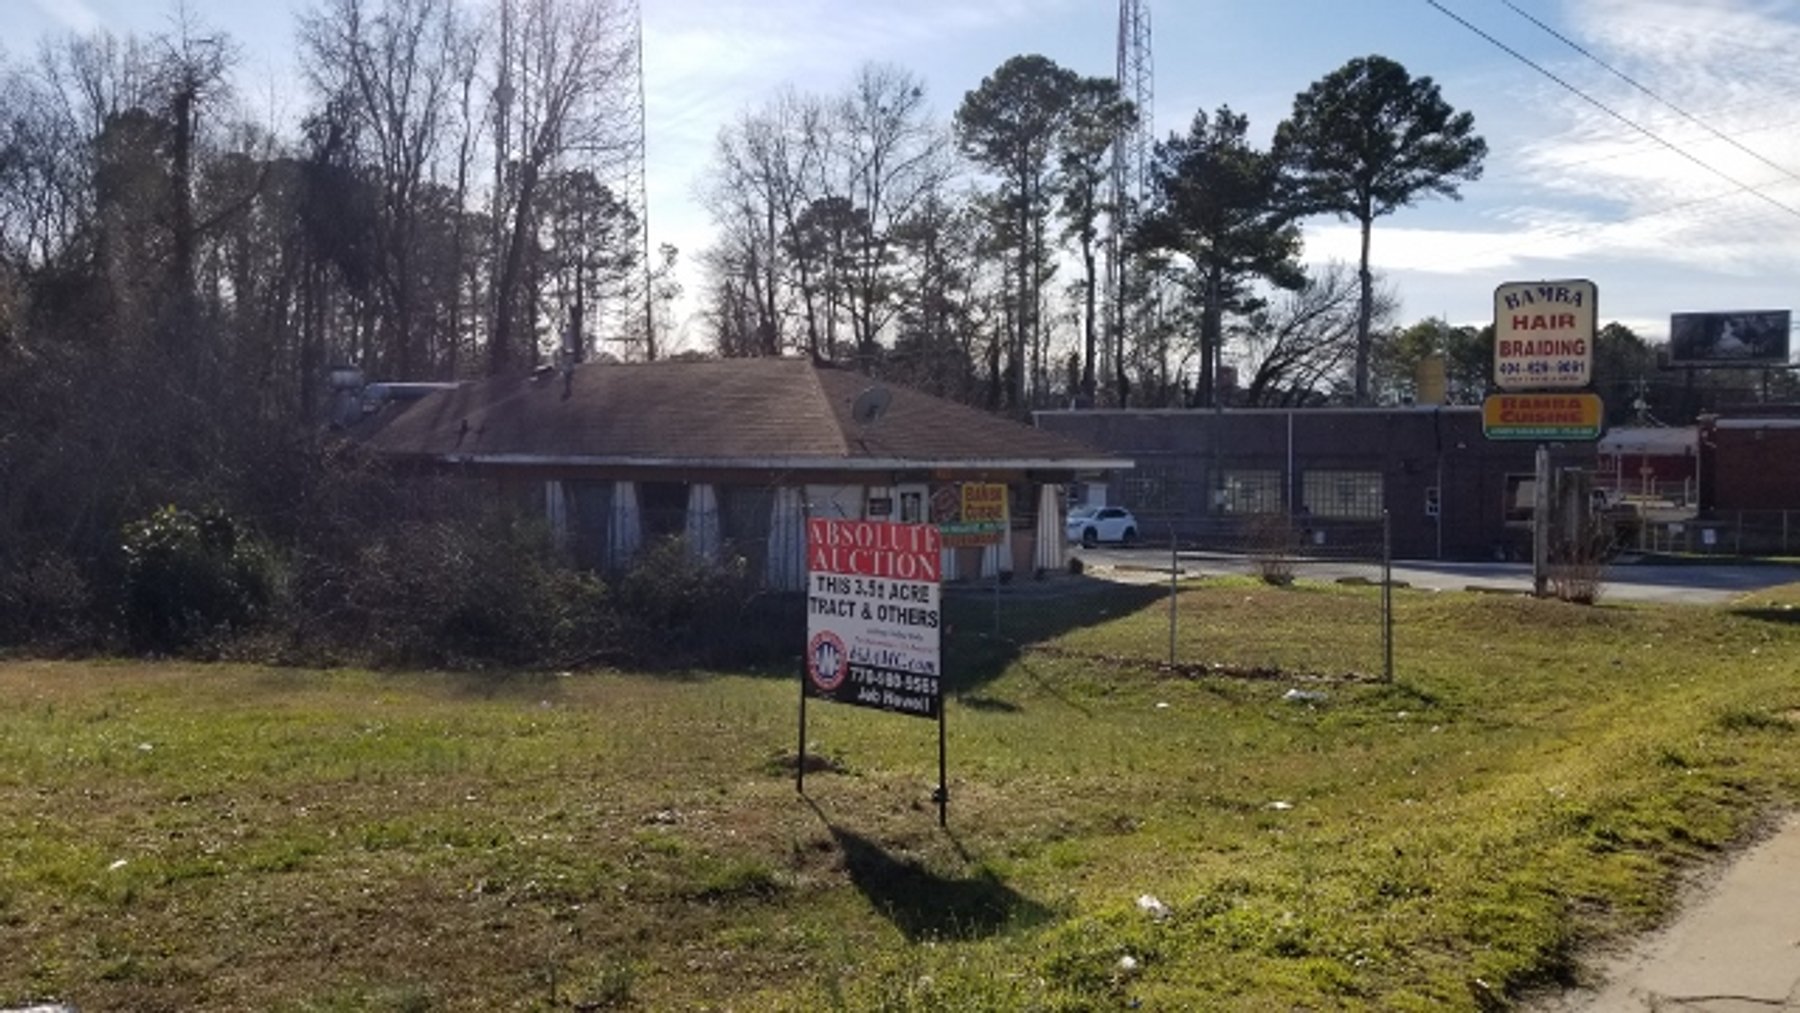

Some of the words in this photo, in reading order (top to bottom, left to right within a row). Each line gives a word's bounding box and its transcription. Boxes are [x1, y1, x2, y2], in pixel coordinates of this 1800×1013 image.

[1505, 287, 1582, 310] BAMBA
[1512, 313, 1576, 330] HAIR
[1500, 339, 1585, 357] BRAIDING
[810, 521, 939, 553] ABSOLUTE
[812, 548, 936, 579] AUCTION
[817, 576, 850, 595] THIS
[889, 583, 929, 603] ACRE
[810, 596, 856, 618] TRACT
[861, 602, 872, 620] &
[878, 604, 938, 628] OTHERS
